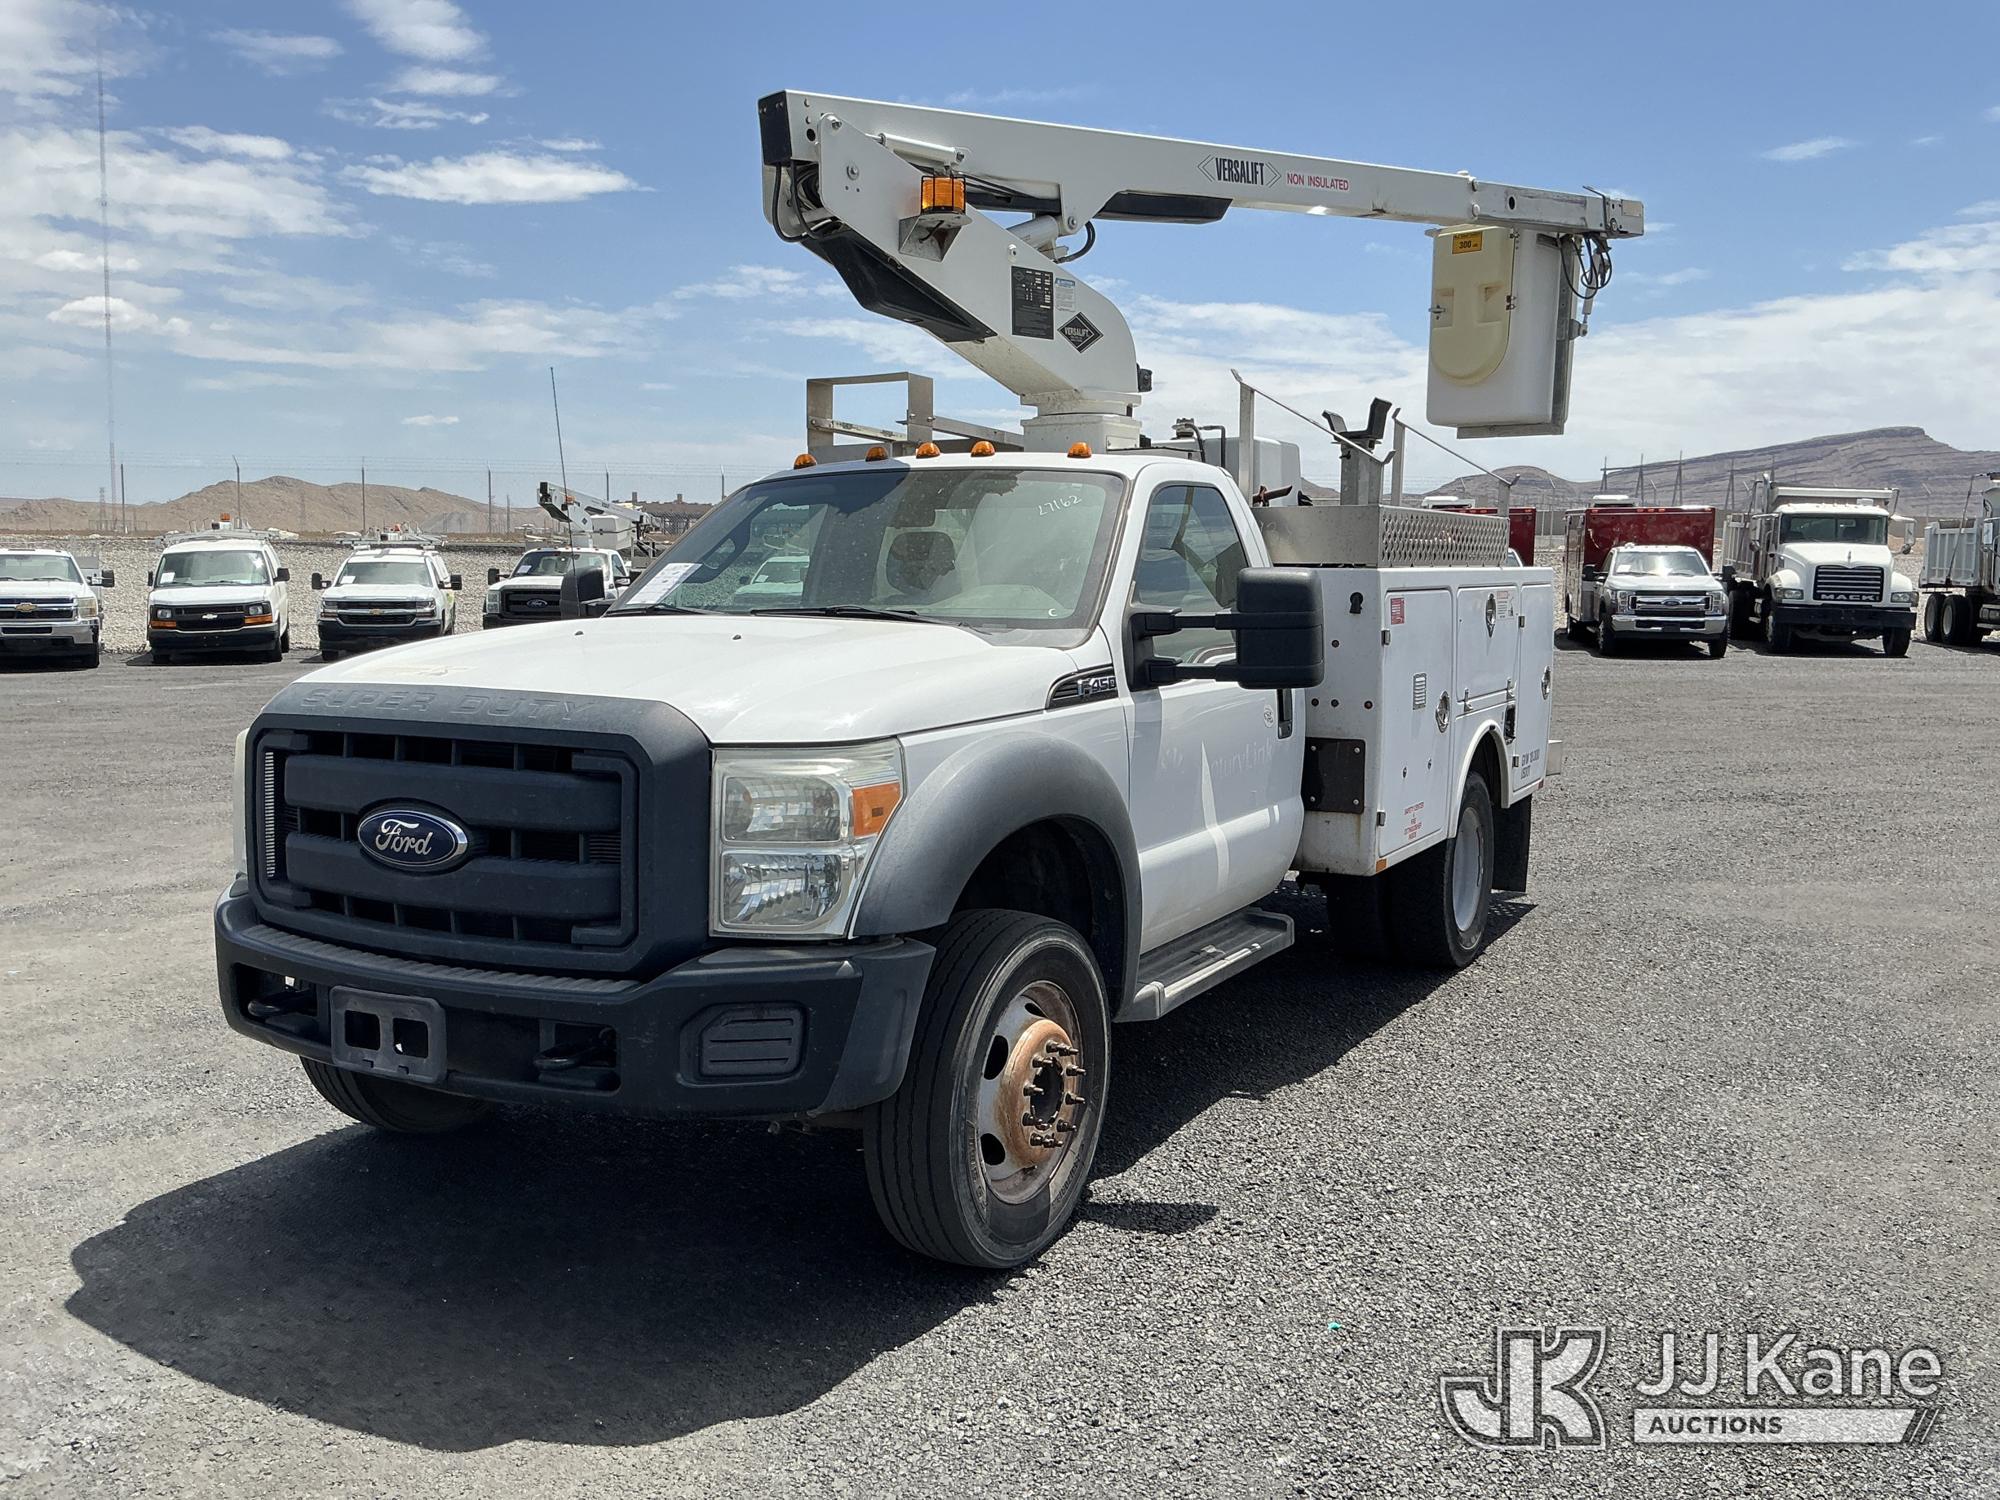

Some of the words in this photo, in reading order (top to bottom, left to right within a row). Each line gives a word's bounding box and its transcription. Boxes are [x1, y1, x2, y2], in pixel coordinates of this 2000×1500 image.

[1215, 157, 1265, 186] VERSALIFT
[1287, 173, 1305, 186] NON
[1308, 177, 1350, 191] INSULATED
[1064, 327, 1089, 338] VERSALIFT
[301, 688, 437, 712] SUPER
[451, 694, 598, 720] DUTY
[374, 818, 434, 857] Ford
